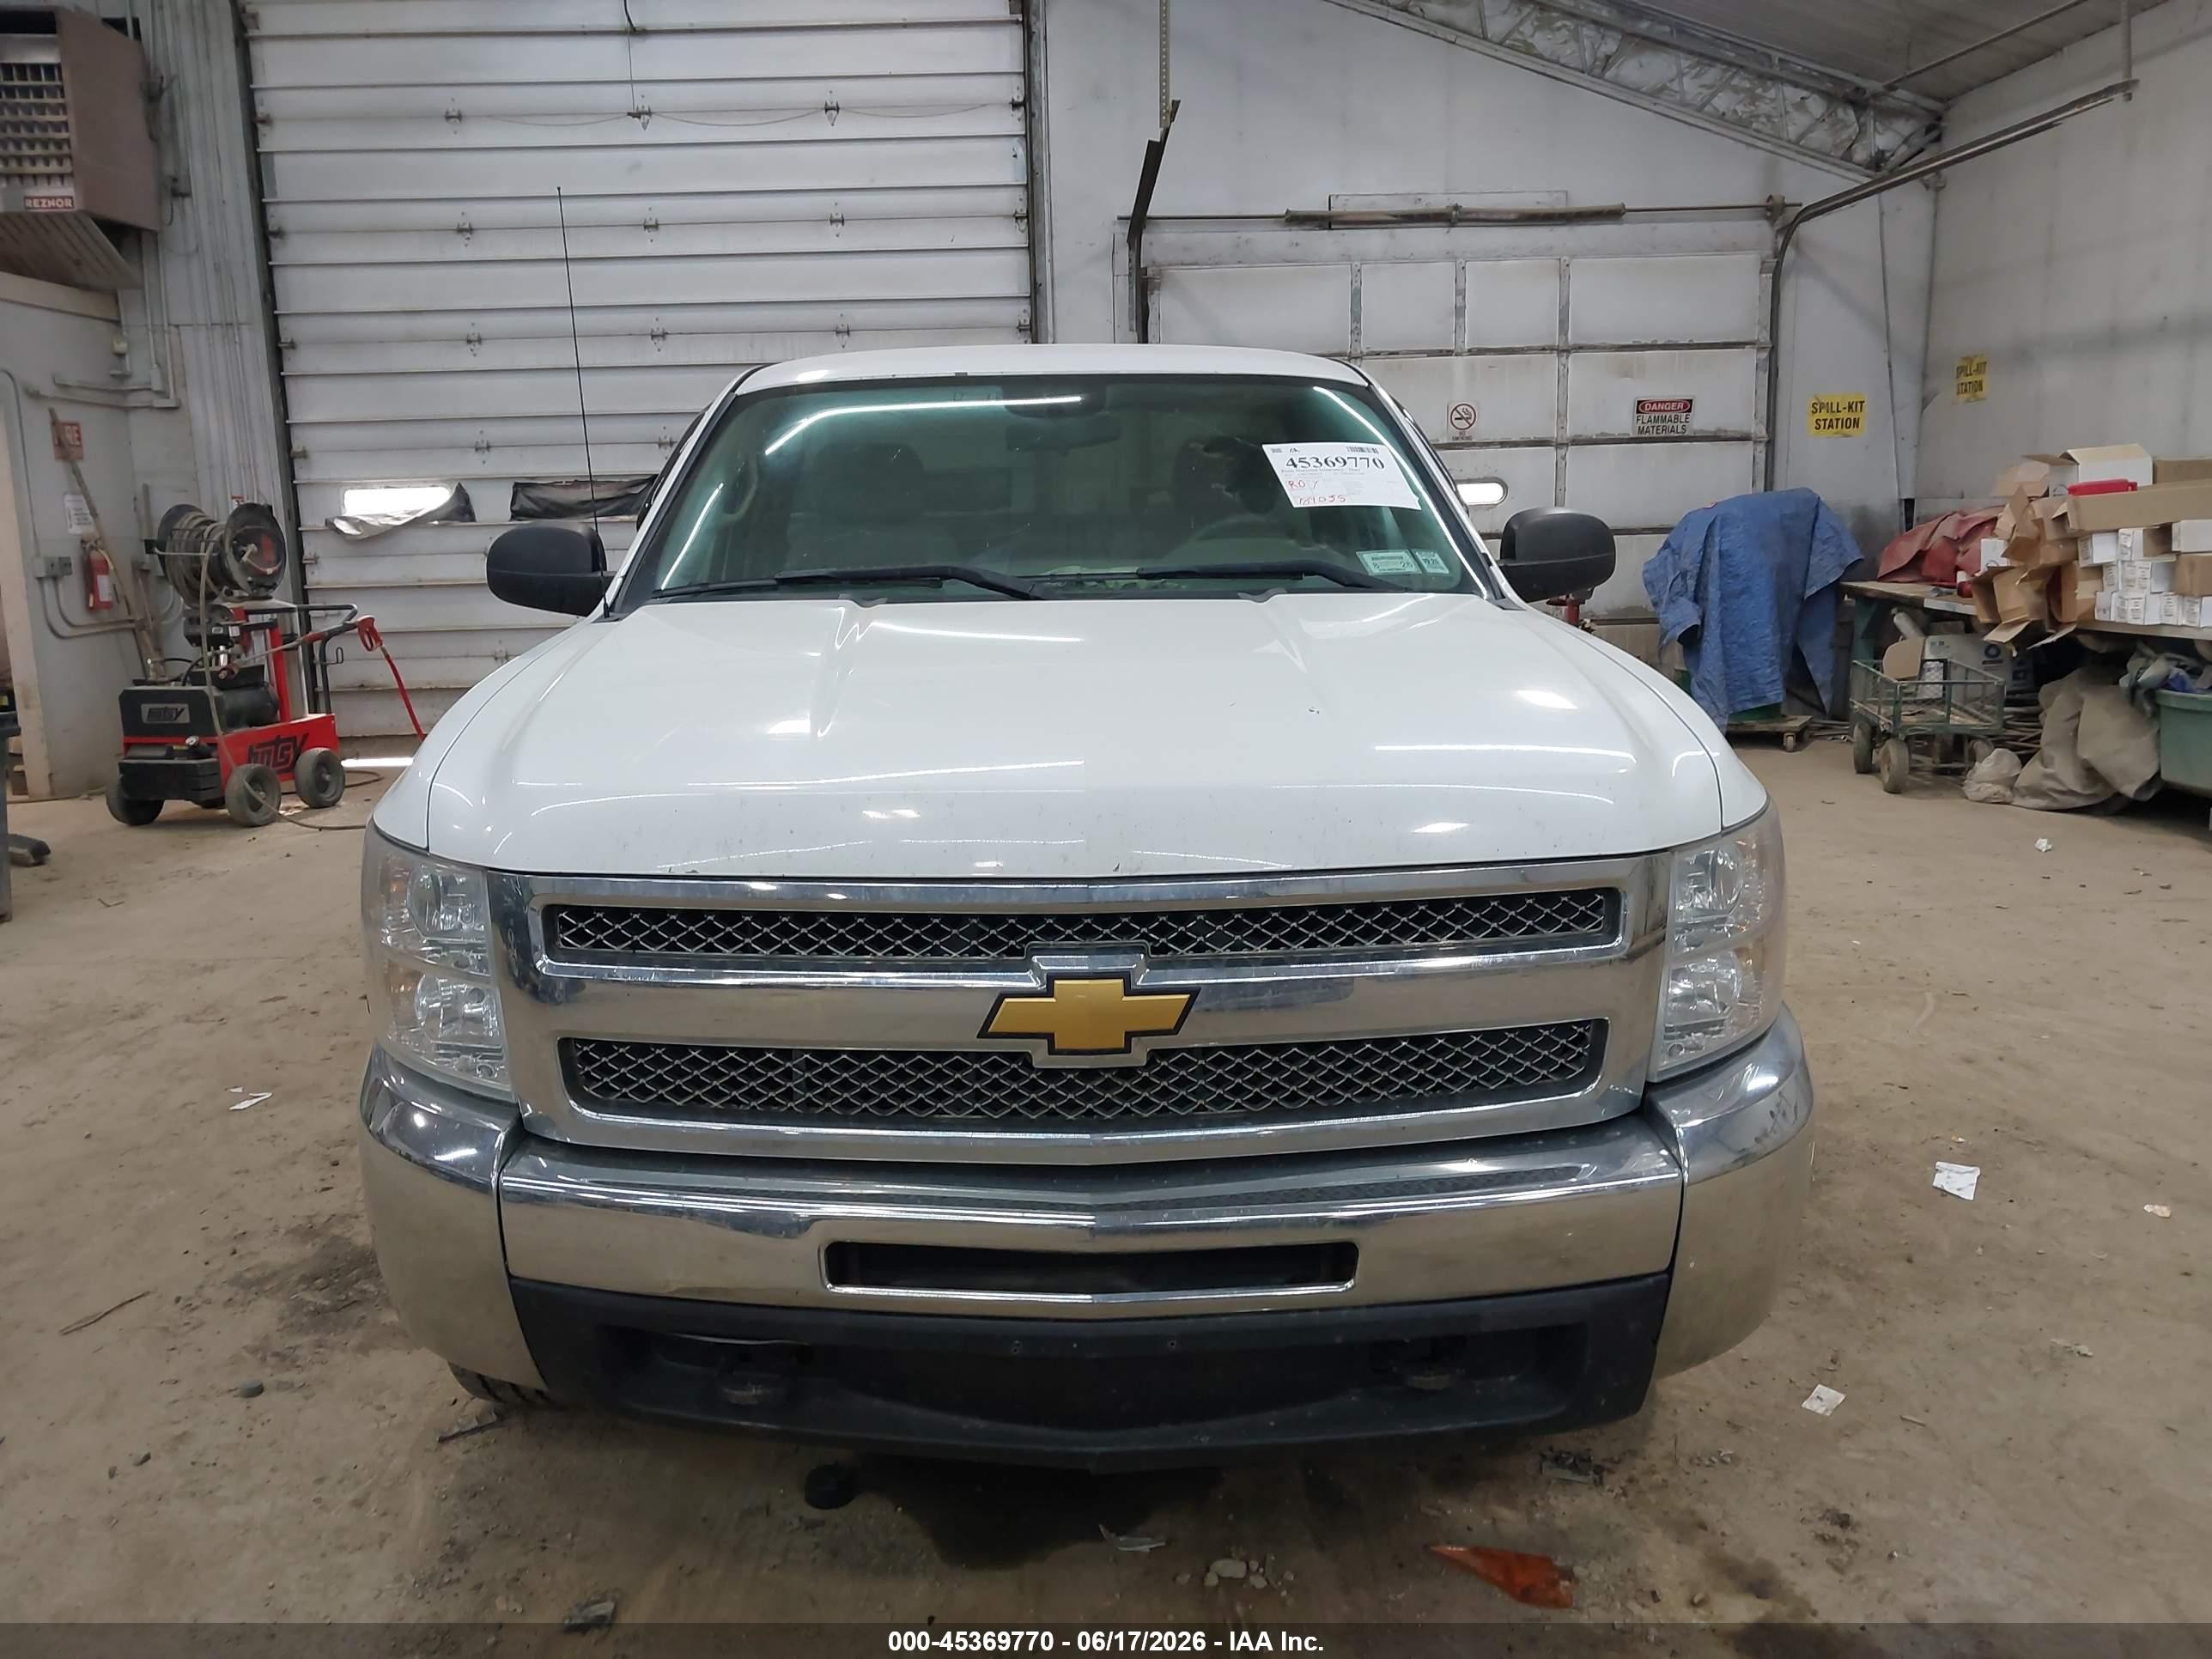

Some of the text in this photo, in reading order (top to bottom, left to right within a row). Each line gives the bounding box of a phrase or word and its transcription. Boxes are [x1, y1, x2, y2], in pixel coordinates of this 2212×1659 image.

[26, 198, 72, 207] REZNOR
[1957, 380, 1983, 396] STATION
[1644, 402, 1684, 411] DANGER
[1811, 400, 1865, 414] SPILL-KIT
[1636, 414, 1691, 424] FLAMMABLE
[1814, 417, 1860, 430] STATION
[1638, 425, 1686, 435] MATERIALS
[1286, 457, 1384, 470] 45369770
